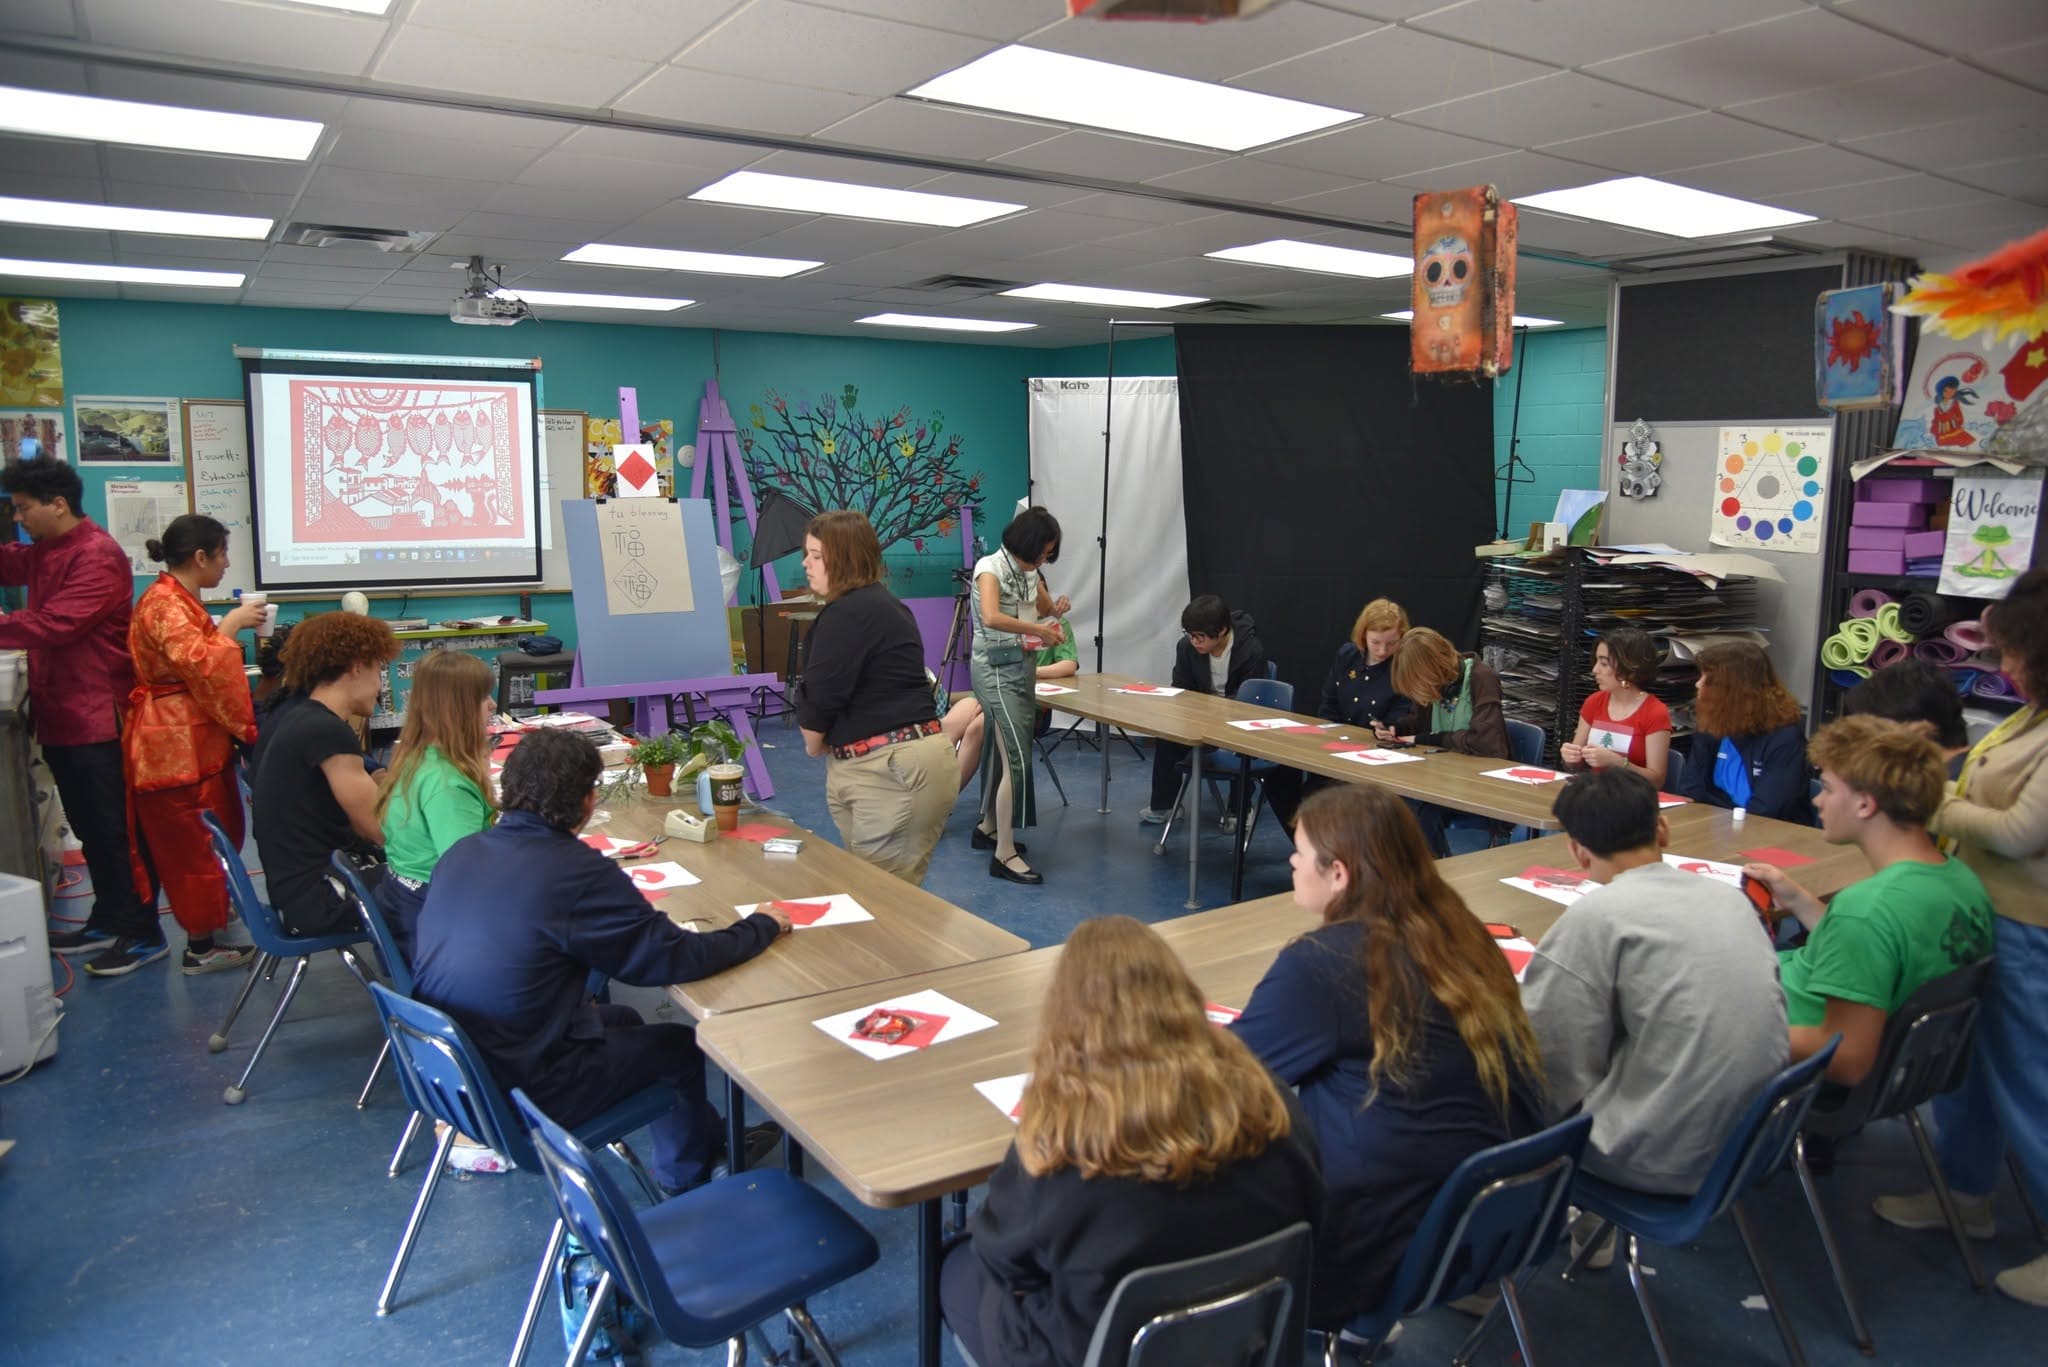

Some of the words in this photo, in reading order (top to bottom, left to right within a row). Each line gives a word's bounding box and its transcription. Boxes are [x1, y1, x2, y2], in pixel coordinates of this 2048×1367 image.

[1060, 380, 1090, 390] Kate
[629, 503, 669, 521] blessing
[1952, 487, 2038, 522] Welcome
